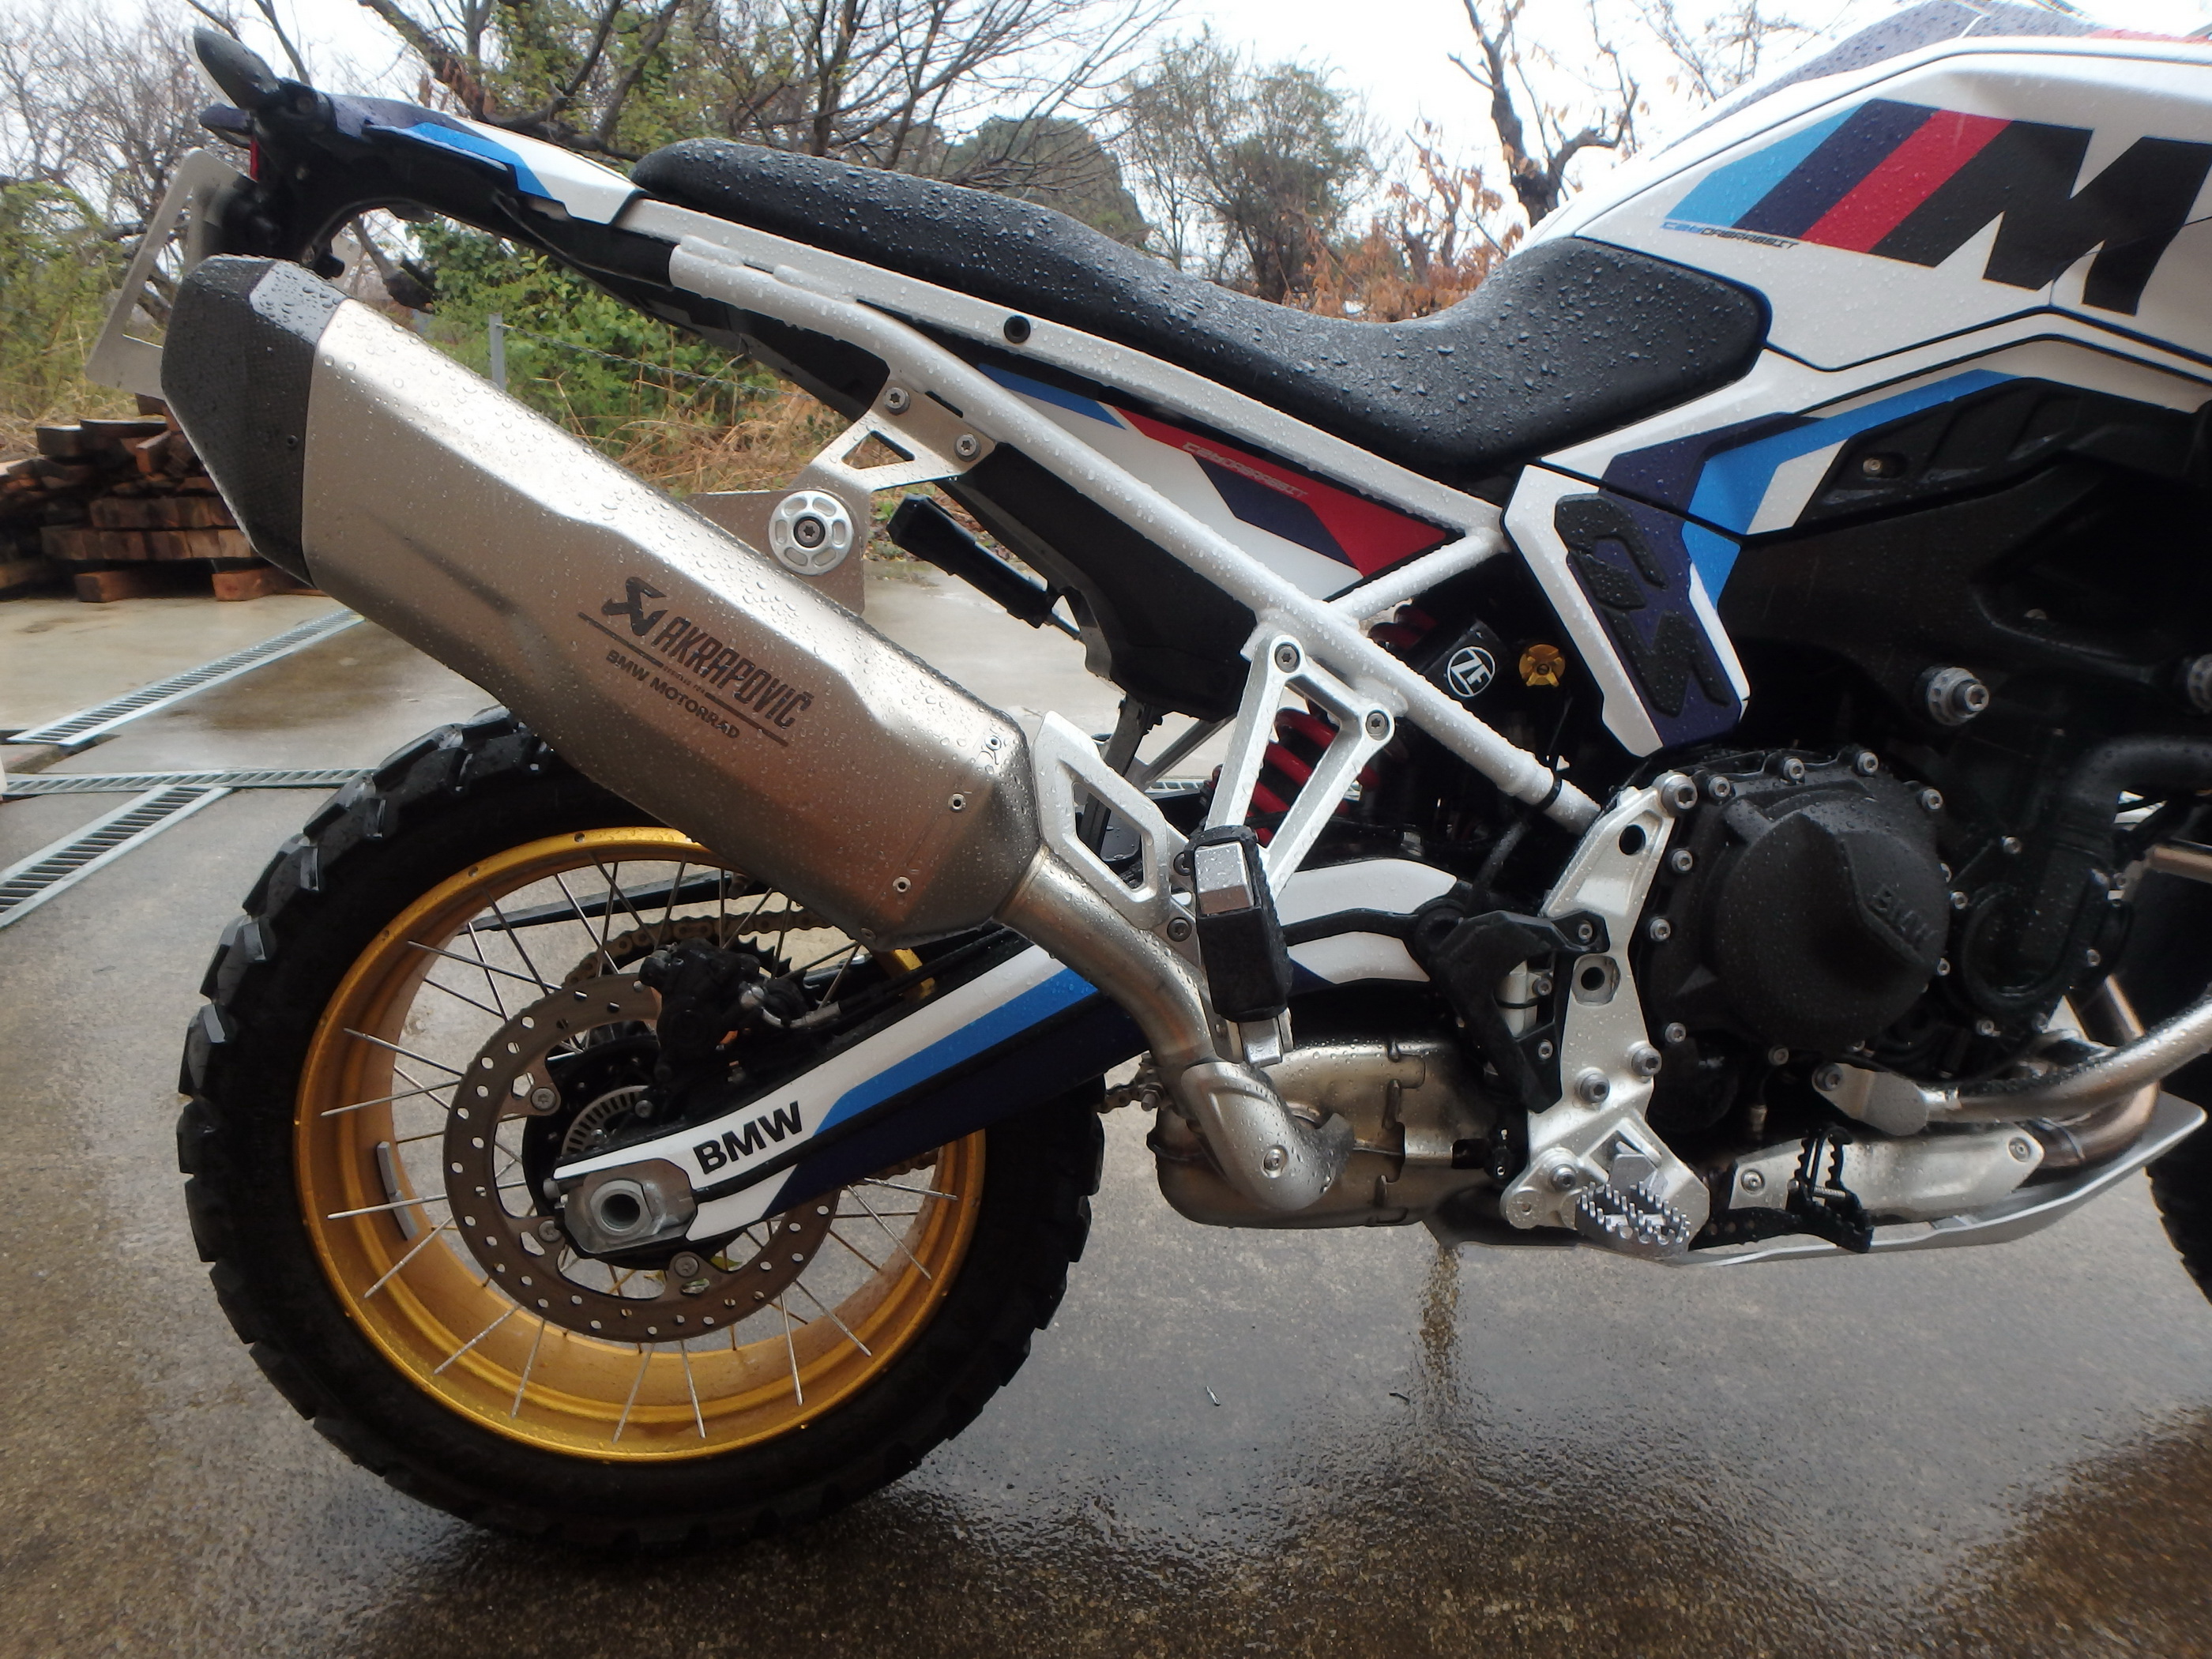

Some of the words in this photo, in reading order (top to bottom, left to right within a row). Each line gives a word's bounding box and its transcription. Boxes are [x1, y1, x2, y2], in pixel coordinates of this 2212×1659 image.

[1867, 119, 2212, 317] M
[1555, 493, 1732, 717] GS
[606, 649, 650, 682] BMW
[649, 676, 740, 739] MOTORRAD
[1447, 646, 1495, 697] ZF
[1872, 882, 1939, 946] BMW
[693, 1100, 803, 1176] BMW
